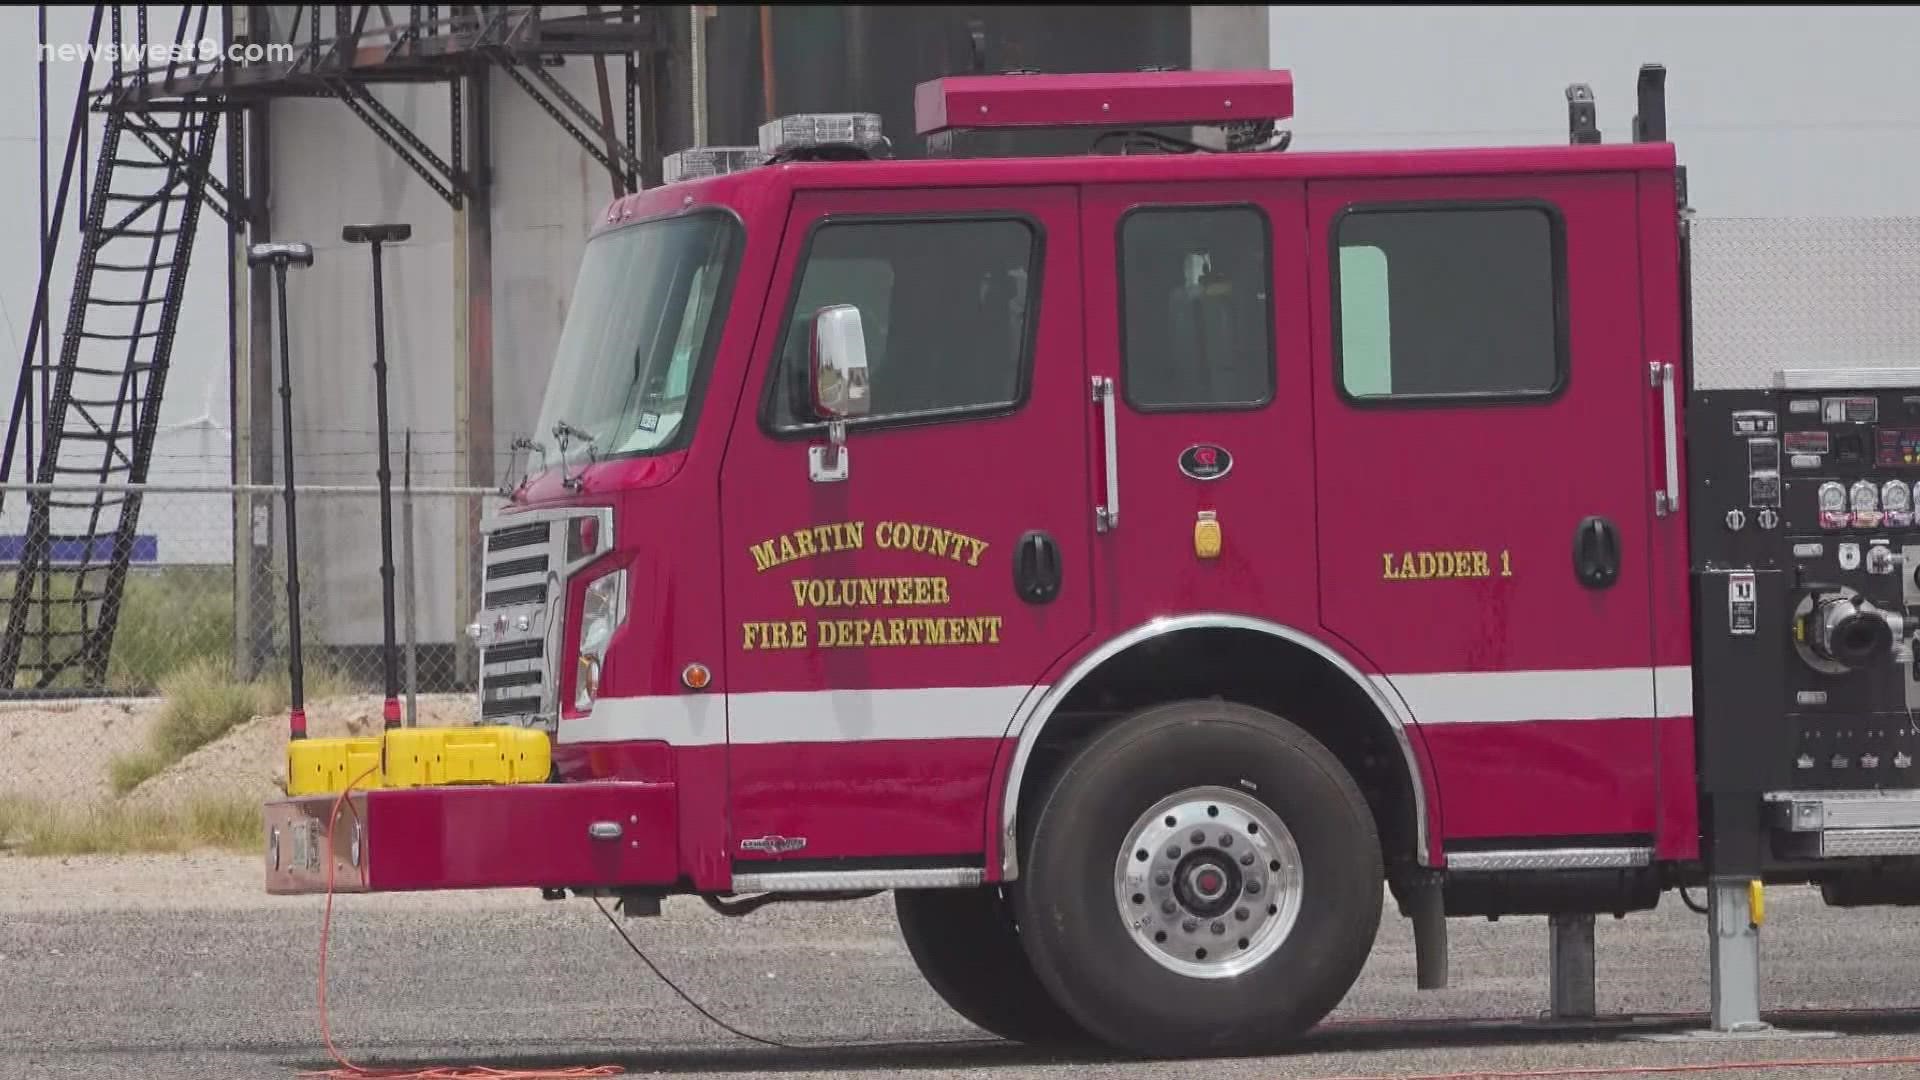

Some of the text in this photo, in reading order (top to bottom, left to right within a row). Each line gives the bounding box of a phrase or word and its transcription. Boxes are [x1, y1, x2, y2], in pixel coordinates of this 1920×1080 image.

[750, 521, 989, 572] MARTIN COUNTY
[1383, 550, 1513, 579] LADDER 1
[792, 577, 949, 607] VOLUNTEER
[743, 616, 1002, 650] FIRE DEPARTMENT
